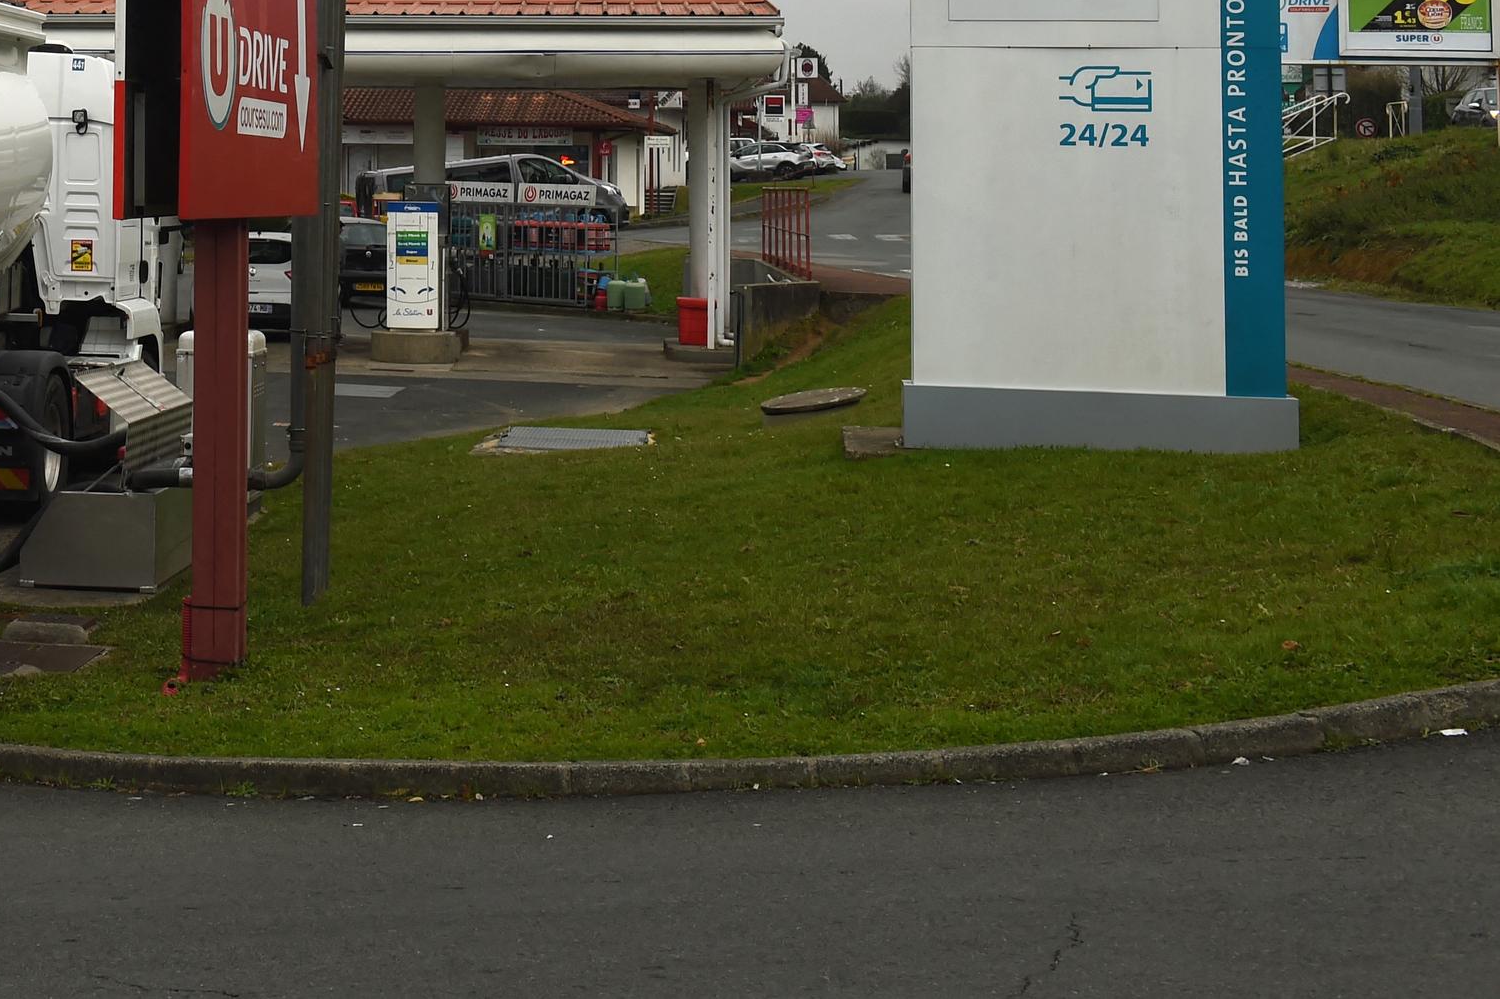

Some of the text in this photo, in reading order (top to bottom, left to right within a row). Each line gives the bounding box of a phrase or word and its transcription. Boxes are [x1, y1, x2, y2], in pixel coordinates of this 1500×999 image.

[1395, 34, 1430, 43] SUPER
[239, 25, 290, 94] DRIVE
[240, 106, 284, 132] coursesu.com
[1059, 122, 1150, 148] 24/24
[1227, 106, 1247, 186] HASTA
[460, 186, 509, 198] PRIMAGAZ
[538, 189, 590, 201] PRIMAGAZ
[1233, 195, 1248, 242] BALD
[1234, 248, 1249, 277] BIS
